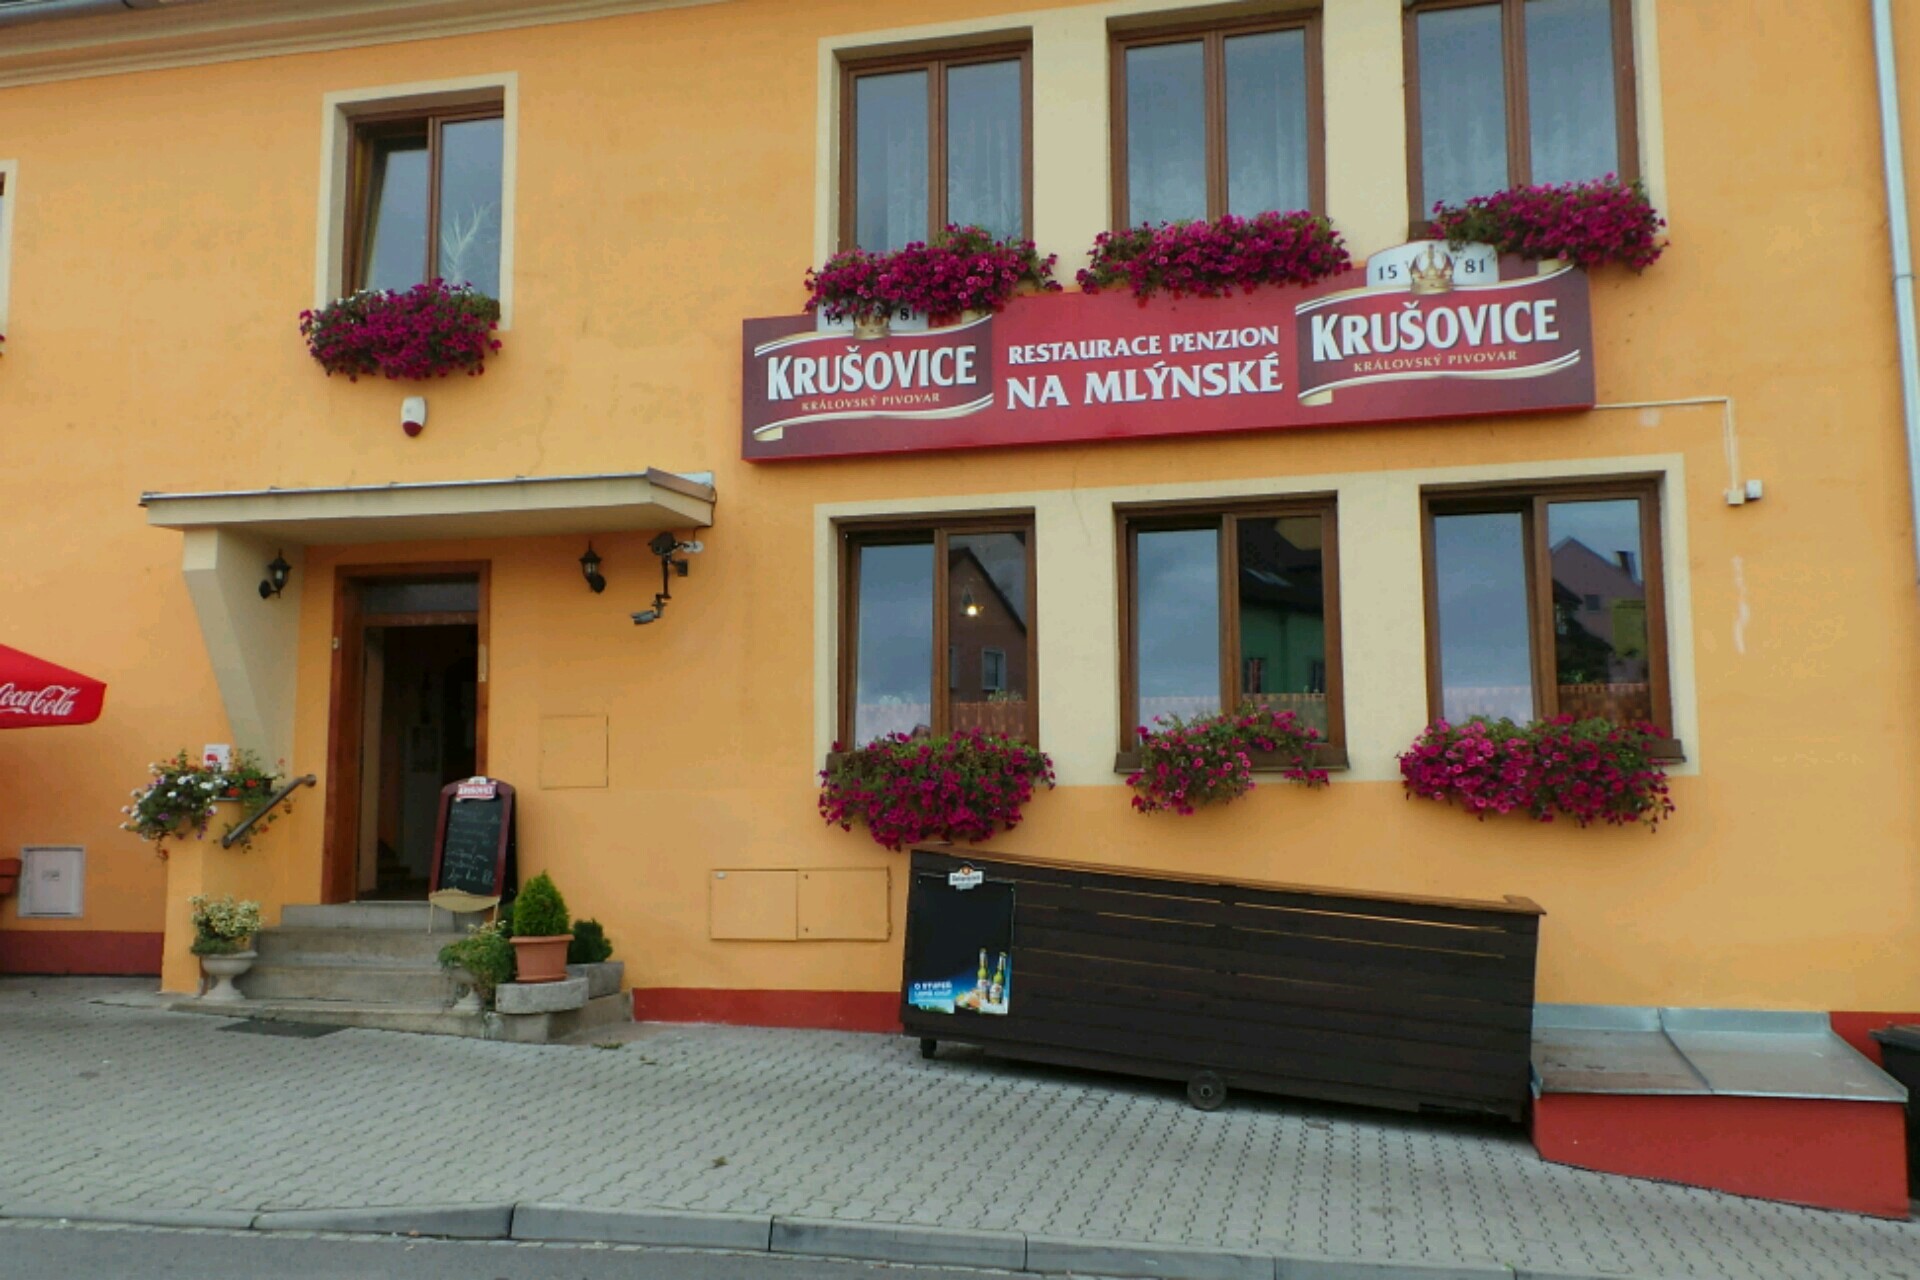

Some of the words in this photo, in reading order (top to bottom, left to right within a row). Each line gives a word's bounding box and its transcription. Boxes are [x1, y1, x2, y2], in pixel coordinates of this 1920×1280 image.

[1377, 264, 1398, 281] 15
[1464, 258, 1486, 274] 81
[1008, 335, 1162, 365] RESTAURACE
[1169, 325, 1280, 353] PENZION
[1310, 299, 1560, 363] KRUŠOVICE
[767, 345, 978, 401] KRUŠOVICE
[1006, 374, 1070, 410] NA
[1084, 351, 1284, 405] MLÝNSKÉ
[1353, 353, 1443, 373] KRÁLOVSKÝ
[1447, 350, 1518, 366] PIVOVAR
[801, 394, 878, 412] KRÁLOVSKÝ
[881, 392, 941, 406] PIVOVAR
